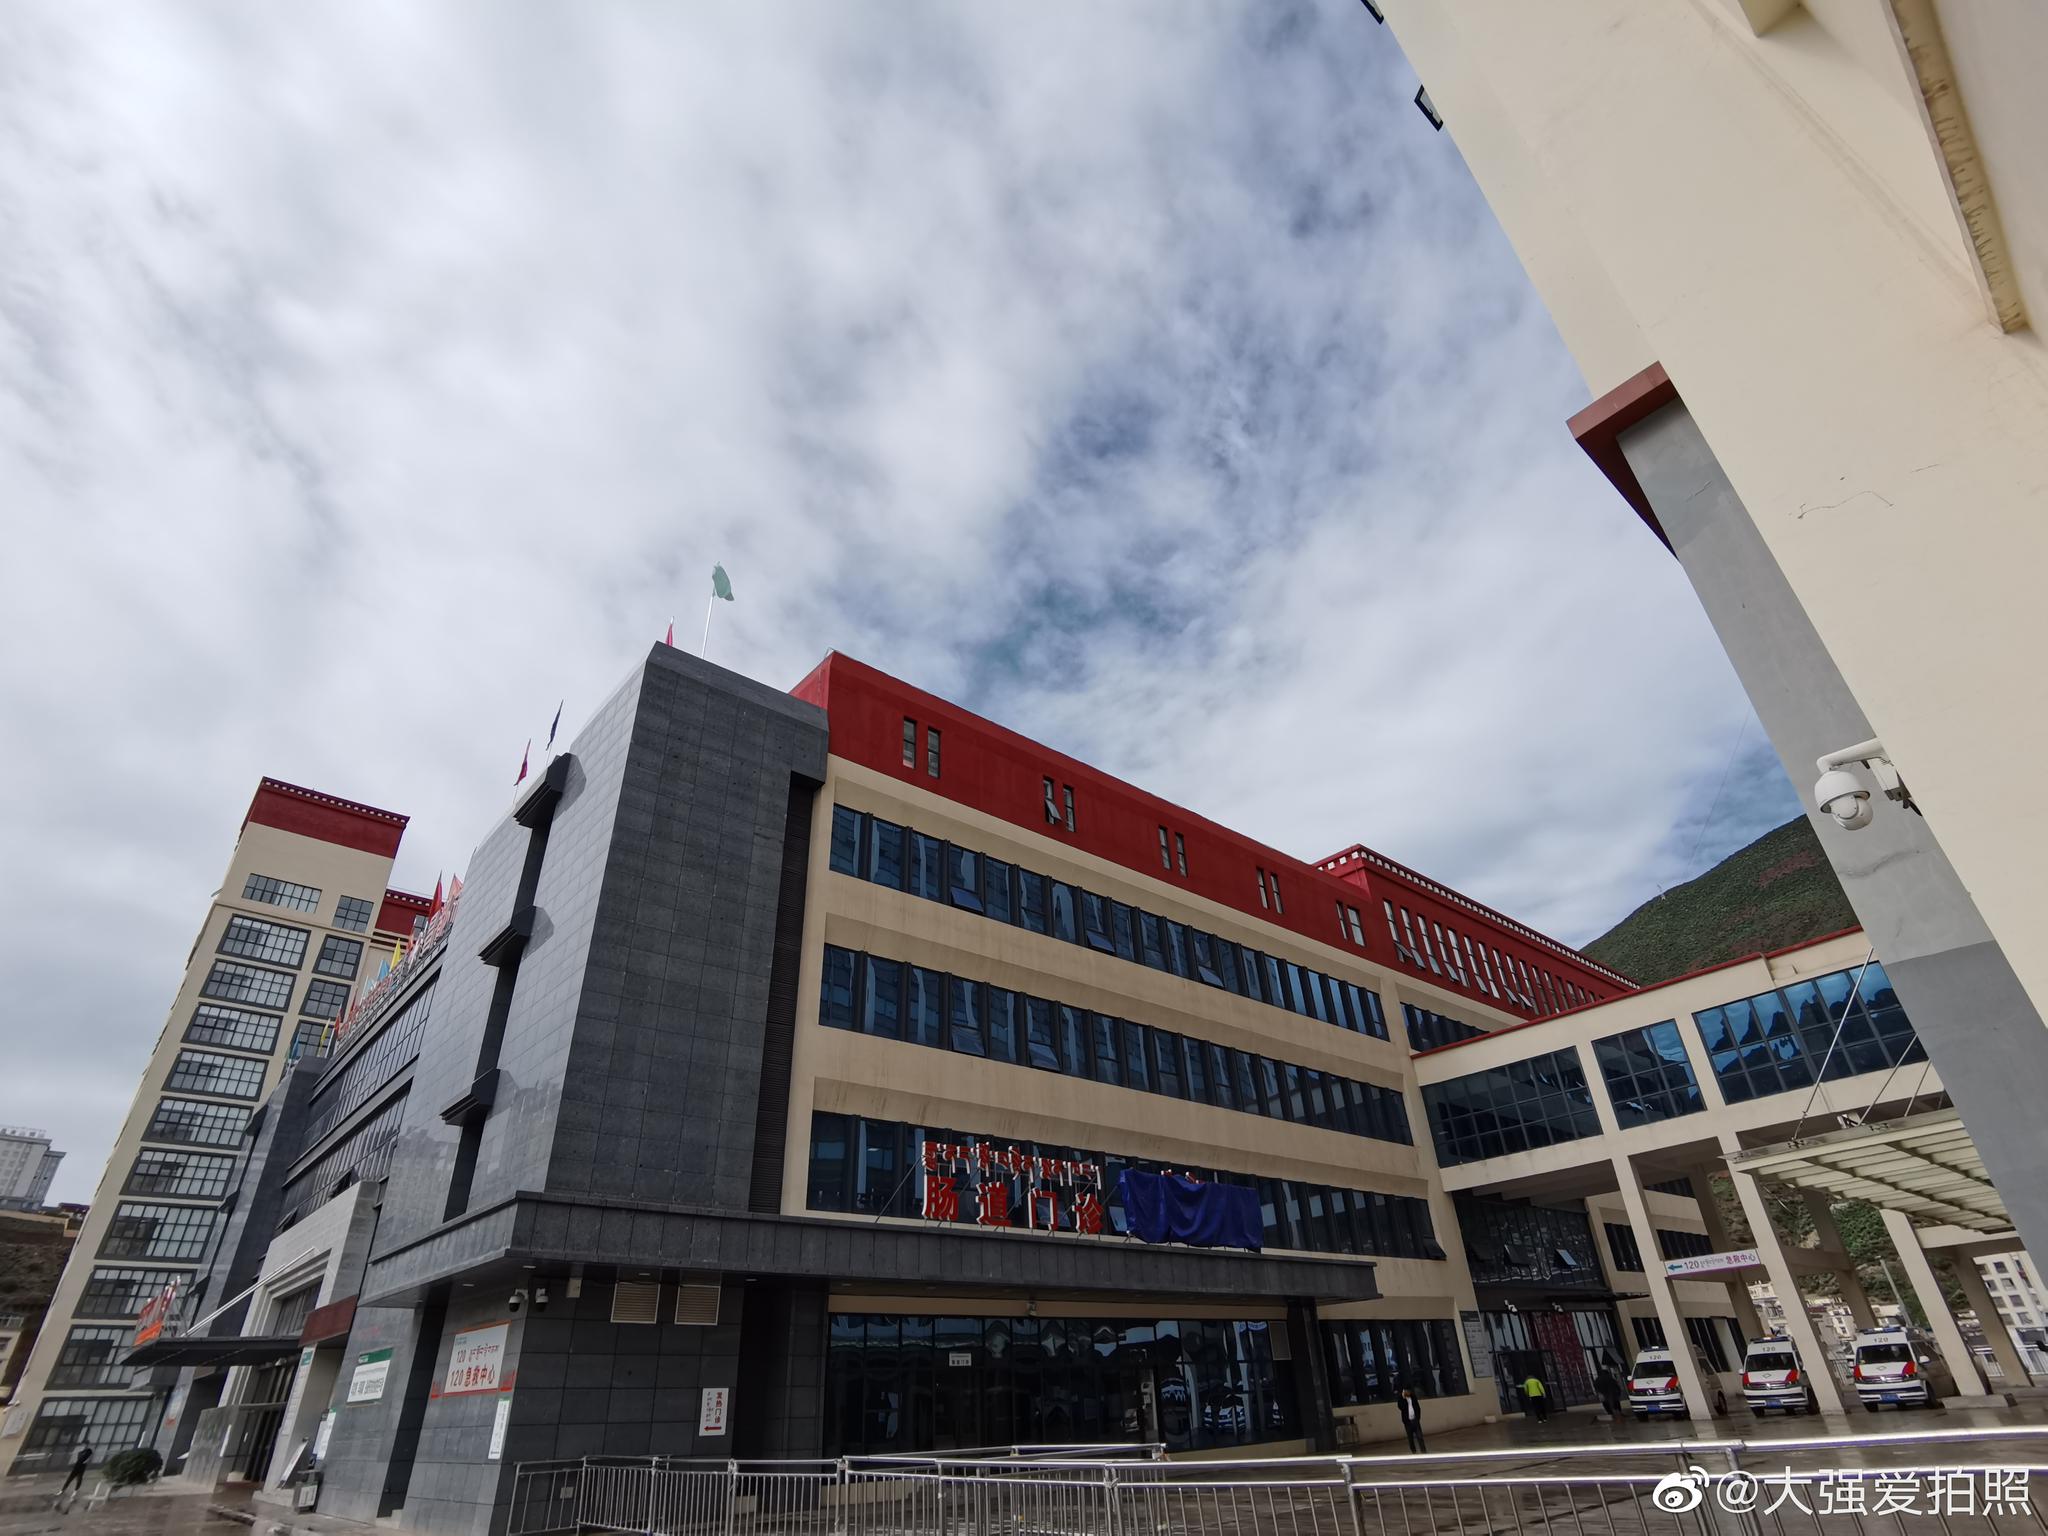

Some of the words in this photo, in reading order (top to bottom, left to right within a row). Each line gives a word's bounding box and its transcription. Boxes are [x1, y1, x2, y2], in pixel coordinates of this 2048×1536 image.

[922, 1175, 1105, 1235] 肠道门诊
[1683, 1260, 1700, 1270] 120
